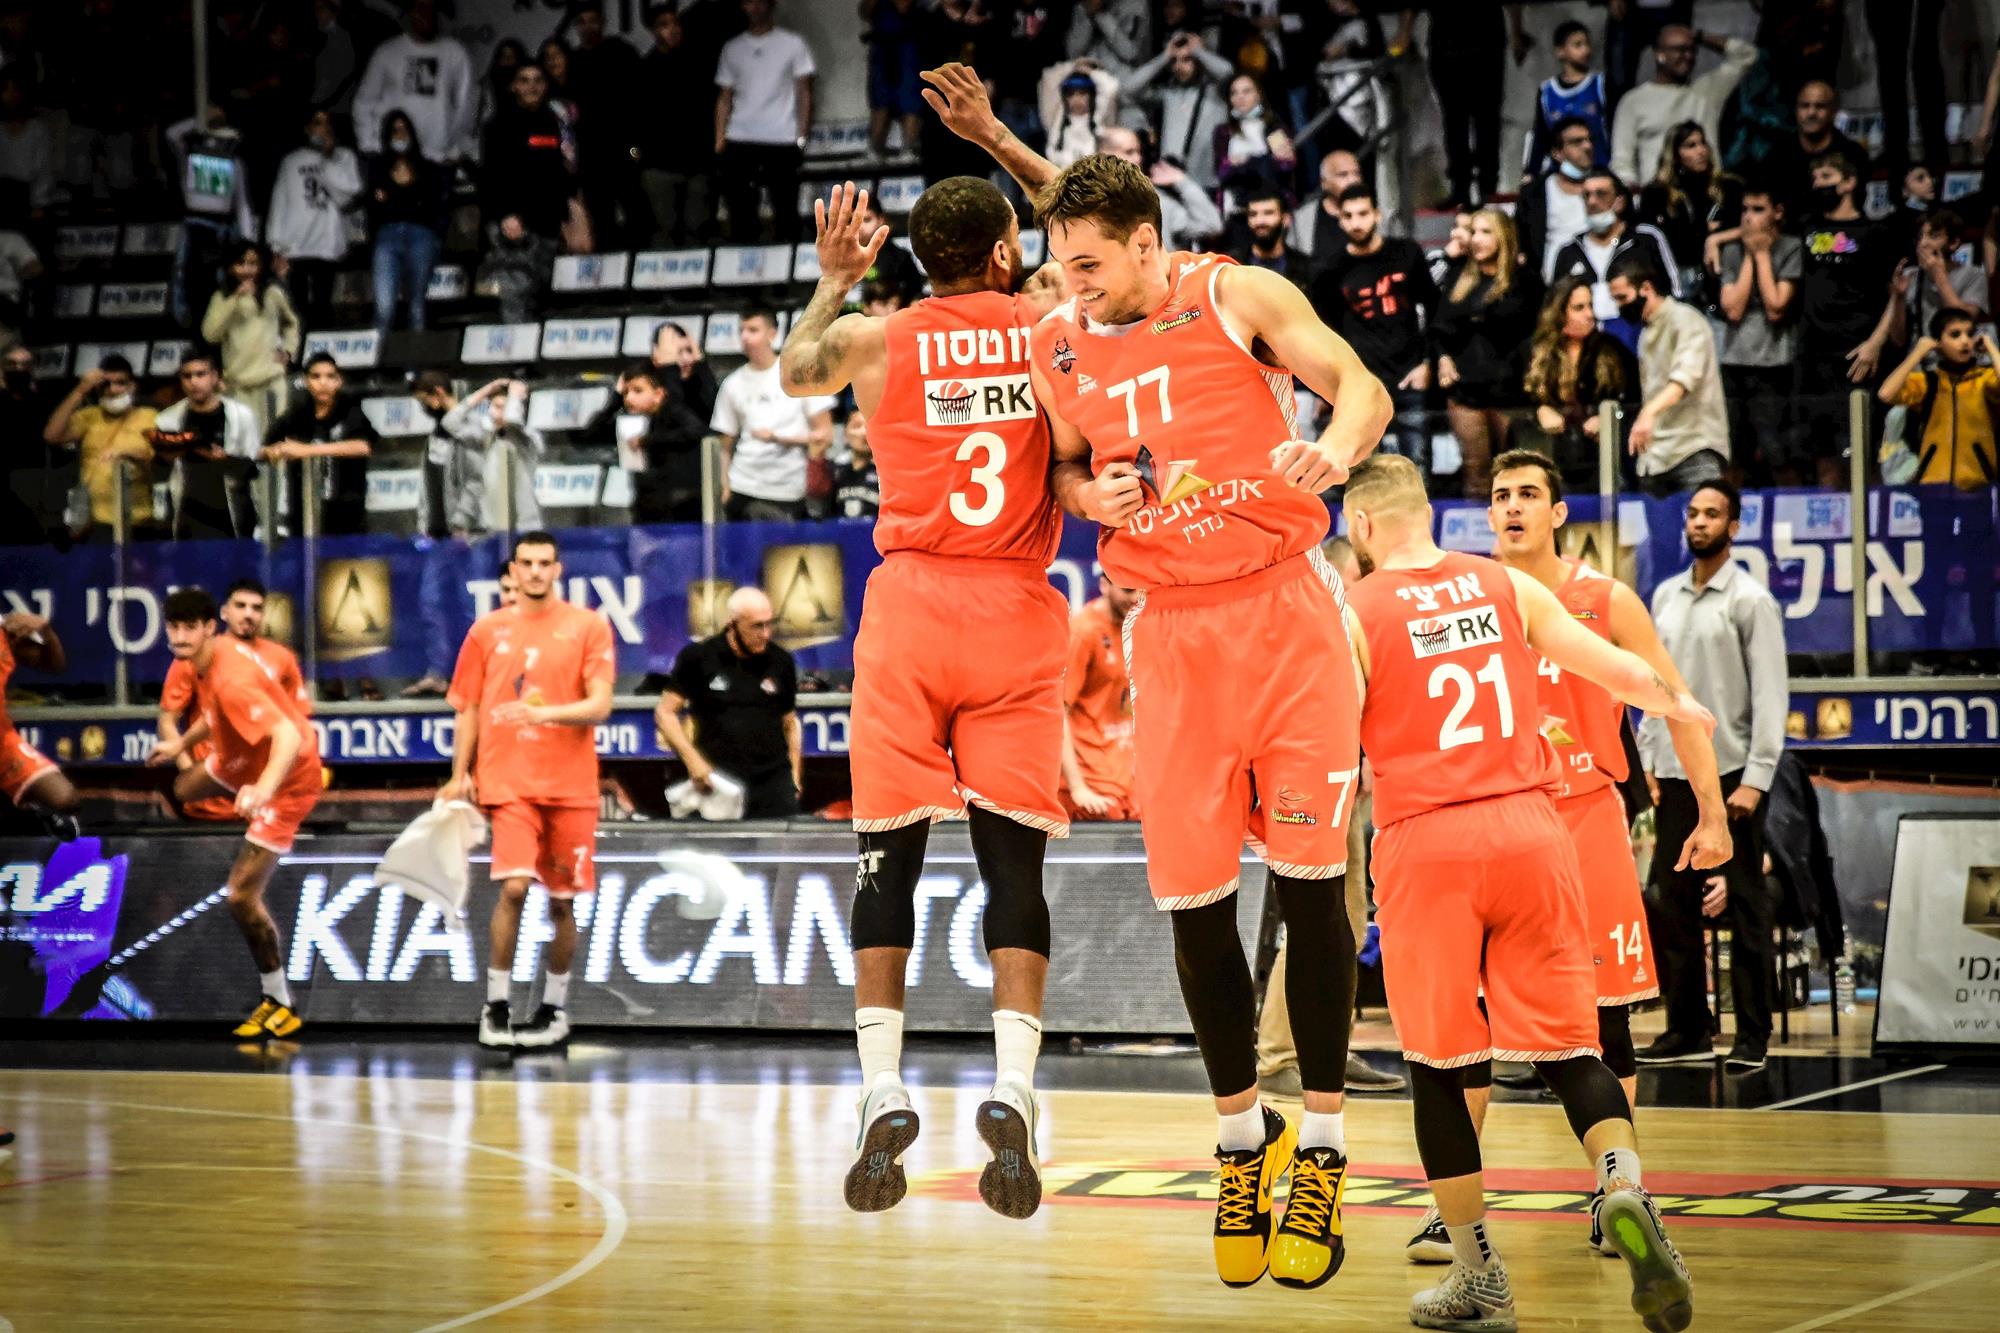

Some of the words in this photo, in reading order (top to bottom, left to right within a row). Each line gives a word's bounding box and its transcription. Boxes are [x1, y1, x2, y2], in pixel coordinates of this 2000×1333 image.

[1153, 316, 1192, 333] Winner
[916, 327, 1031, 375] ווטסון
[983, 382, 1033, 416] RK
[1106, 364, 1173, 439] 77
[949, 431, 1007, 527] 3
[1396, 572, 1486, 612] ארצי
[1457, 612, 1499, 643] RK
[524, 647, 539, 670] 7
[1538, 656, 1561, 685] 4
[1428, 653, 1515, 751] 21
[1874, 697, 1999, 741] רהמי
[122, 730, 158, 761] ילת
[421, 719, 454, 758] סי
[595, 725, 637, 754] חיפ
[1570, 752, 1594, 774] פי
[1327, 765, 1360, 828] 7
[1274, 813, 1305, 824] Winner
[573, 845, 589, 887] 7
[286, 873, 479, 983] KIA
[1608, 921, 1644, 966] 14
